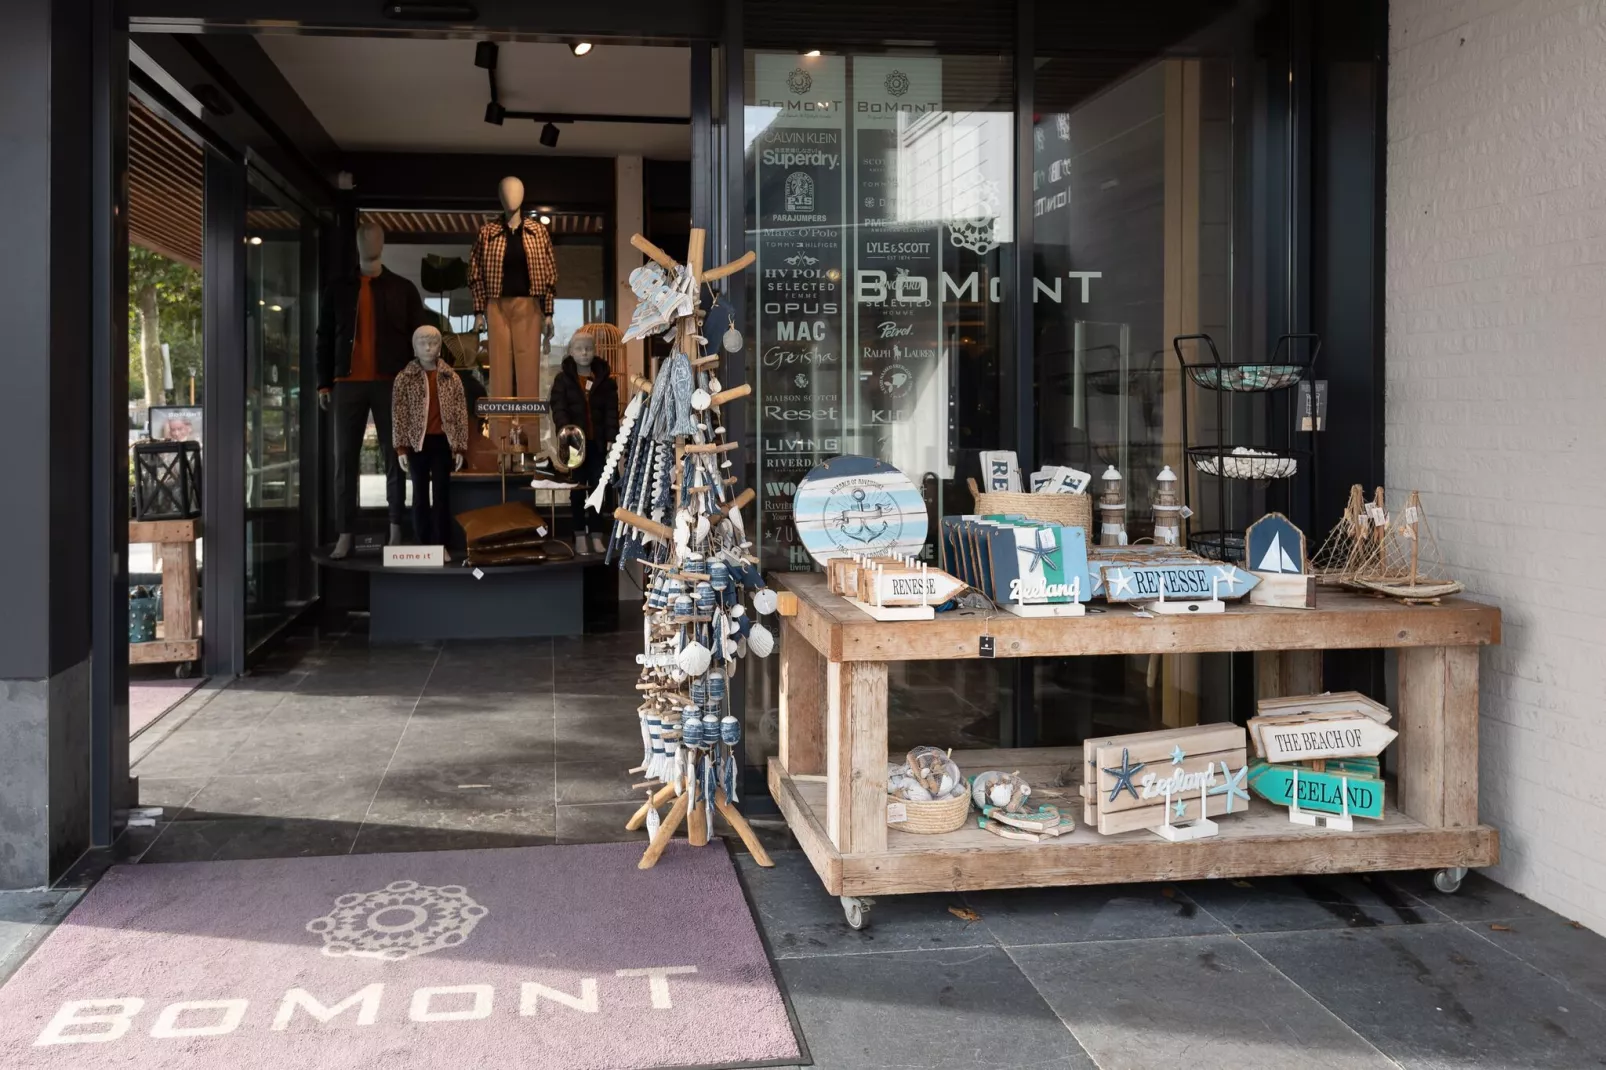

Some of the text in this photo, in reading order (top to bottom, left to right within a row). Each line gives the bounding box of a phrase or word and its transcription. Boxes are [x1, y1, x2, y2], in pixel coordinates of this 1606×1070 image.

[765, 132, 837, 144] CALVIN KLEIN
[773, 214, 827, 222] PARAJUMPERS
[763, 228, 838, 237] Marc O'Polo
[765, 269, 839, 279] HV POLO
[768, 282, 835, 291] SELECTED
[858, 269, 1102, 303] BOMNT
[765, 303, 838, 314] OPUS
[866, 299, 932, 307] SELECTED
[777, 321, 826, 341] MAC
[763, 346, 838, 370] Geisha
[765, 405, 839, 421] Reset
[765, 439, 838, 451] LIVING
[790, 563, 812, 573] Living
[1009, 575, 1081, 600] Zeeland
[1133, 569, 1210, 594] RENESSE
[1275, 728, 1362, 753] THE BEACH OF
[1140, 762, 1217, 800] Zeeland
[1284, 778, 1373, 809] ZEELAND
[32, 965, 698, 1047] BOMONT
